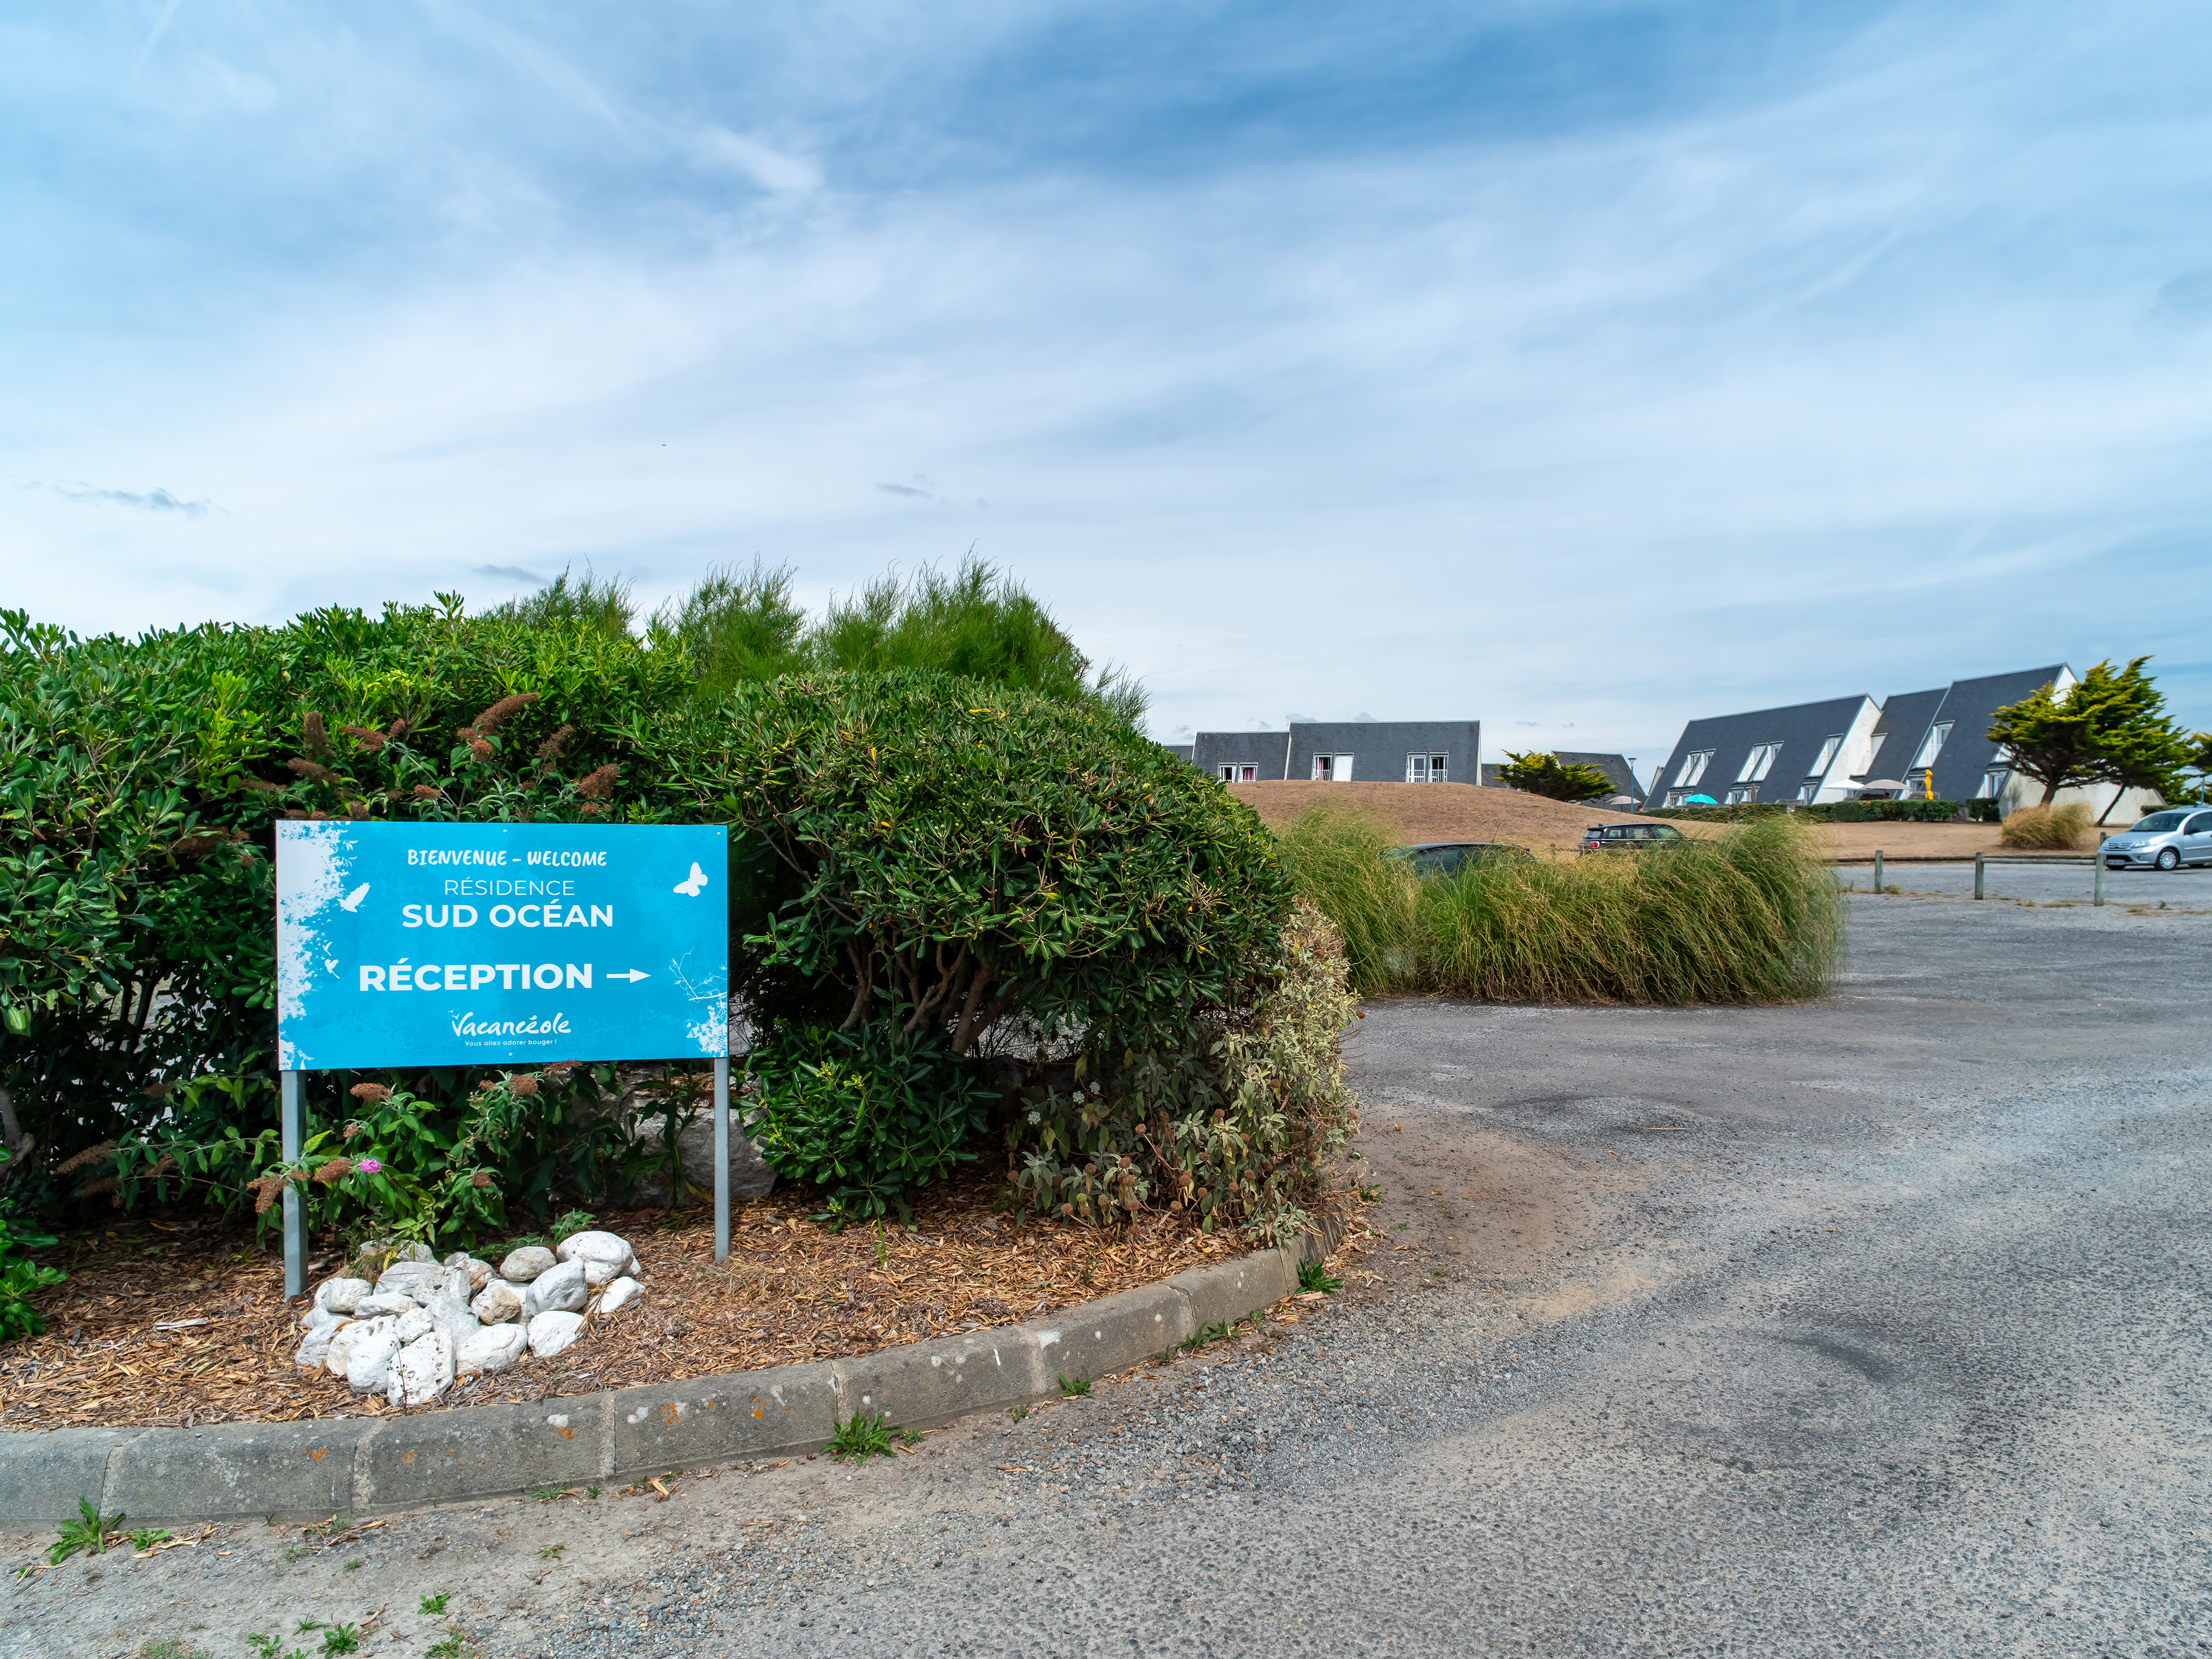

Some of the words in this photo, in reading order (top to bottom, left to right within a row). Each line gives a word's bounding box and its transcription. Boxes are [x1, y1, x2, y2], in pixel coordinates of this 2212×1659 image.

[408, 849, 507, 867] BIENVENUE
[527, 851, 607, 867] WELCOME
[445, 877, 575, 896] RÉSIDENCE
[402, 904, 478, 928] SUD
[489, 899, 613, 928] OCÉAN
[359, 957, 592, 992] RÉCEPTION
[451, 1011, 571, 1037] Vacancéole
